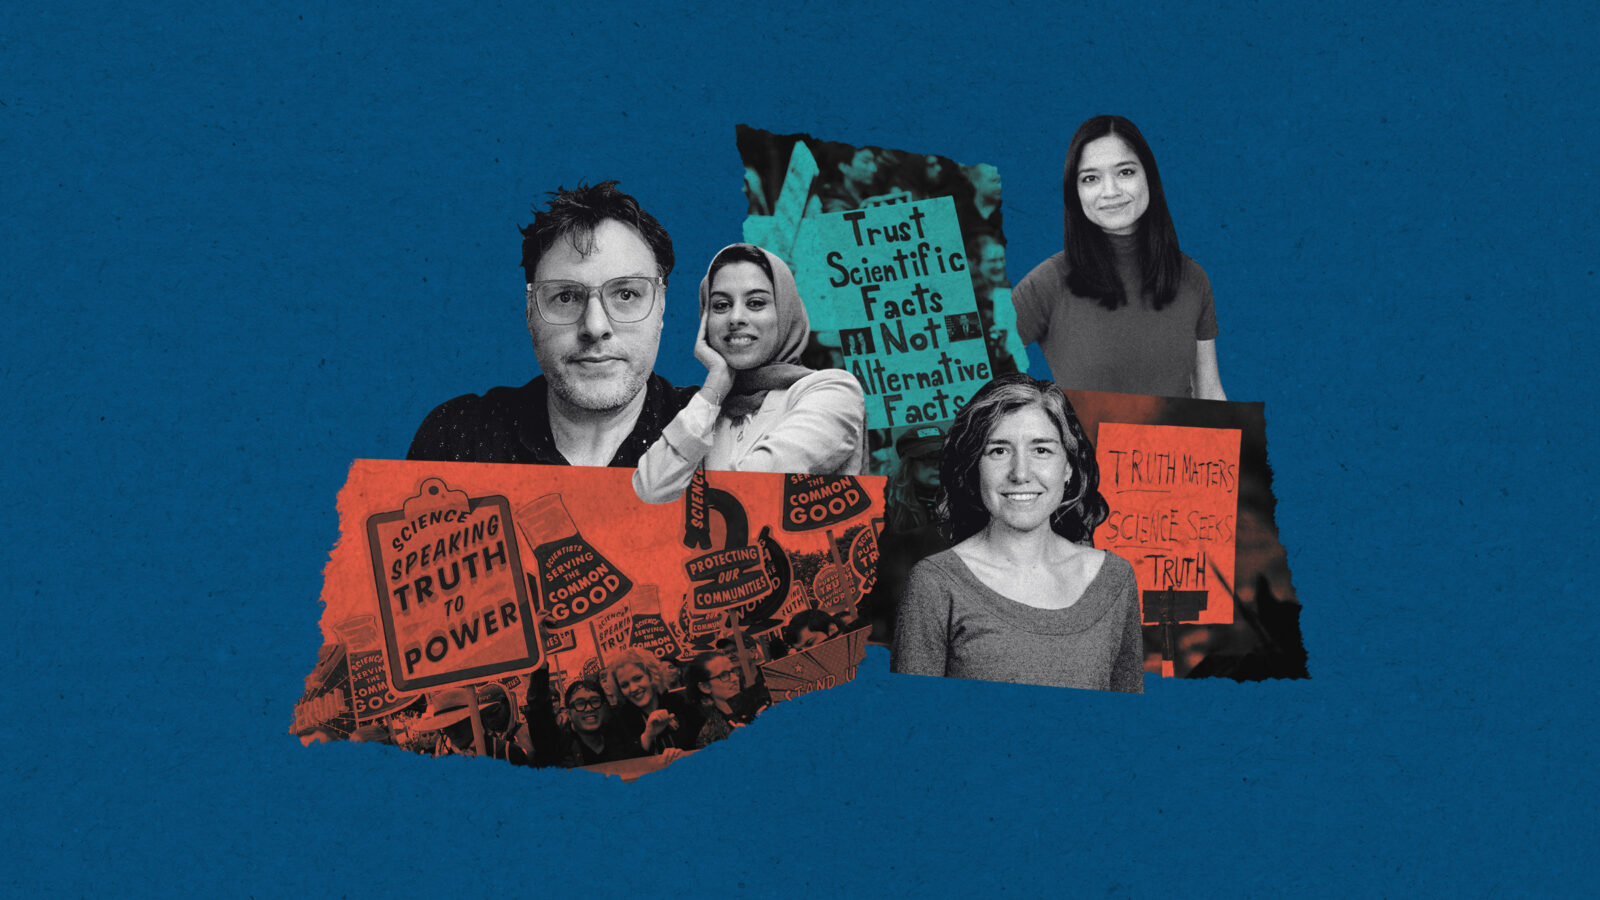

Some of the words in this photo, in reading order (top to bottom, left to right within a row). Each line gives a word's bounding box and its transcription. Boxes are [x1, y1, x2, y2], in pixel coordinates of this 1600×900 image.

[843, 206, 925, 246] Trust
[826, 242, 965, 288] Scientific
[860, 283, 943, 321] Facts
[880, 318, 942, 355] Not
[852, 352, 990, 396] Alternative
[883, 389, 965, 427] Facts
[807, 476, 824, 488] THE
[1109, 449, 1176, 488] TRUTH
[1182, 453, 1236, 493] MATTERS
[790, 476, 852, 506] COMMON
[790, 489, 860, 524] GOOD
[392, 509, 470, 552] SCIENCE
[1106, 509, 1179, 544] SCIENCE
[1187, 510, 1234, 543] SEEKS
[391, 514, 500, 580] SPEAKING
[690, 550, 758, 575] PROTECTING
[393, 541, 507, 612] TRUTH
[546, 552, 594, 582] SERVING
[548, 563, 609, 603] COMMON
[563, 569, 581, 581] THE
[718, 568, 740, 584] OUR
[1143, 551, 1206, 589] TRUTH
[444, 595, 464, 617] TO
[552, 575, 620, 620] GOOD
[696, 576, 767, 605] COMMUNITIES
[405, 602, 518, 674] POWER
[600, 616, 631, 641] SPEAKIN
[601, 627, 631, 652] TRUT
[634, 626, 665, 638] SERVING
[654, 643, 675, 658] OD
[351, 665, 386, 682] SERVIN
[354, 681, 388, 699] COMM
[355, 690, 397, 713] GOO
